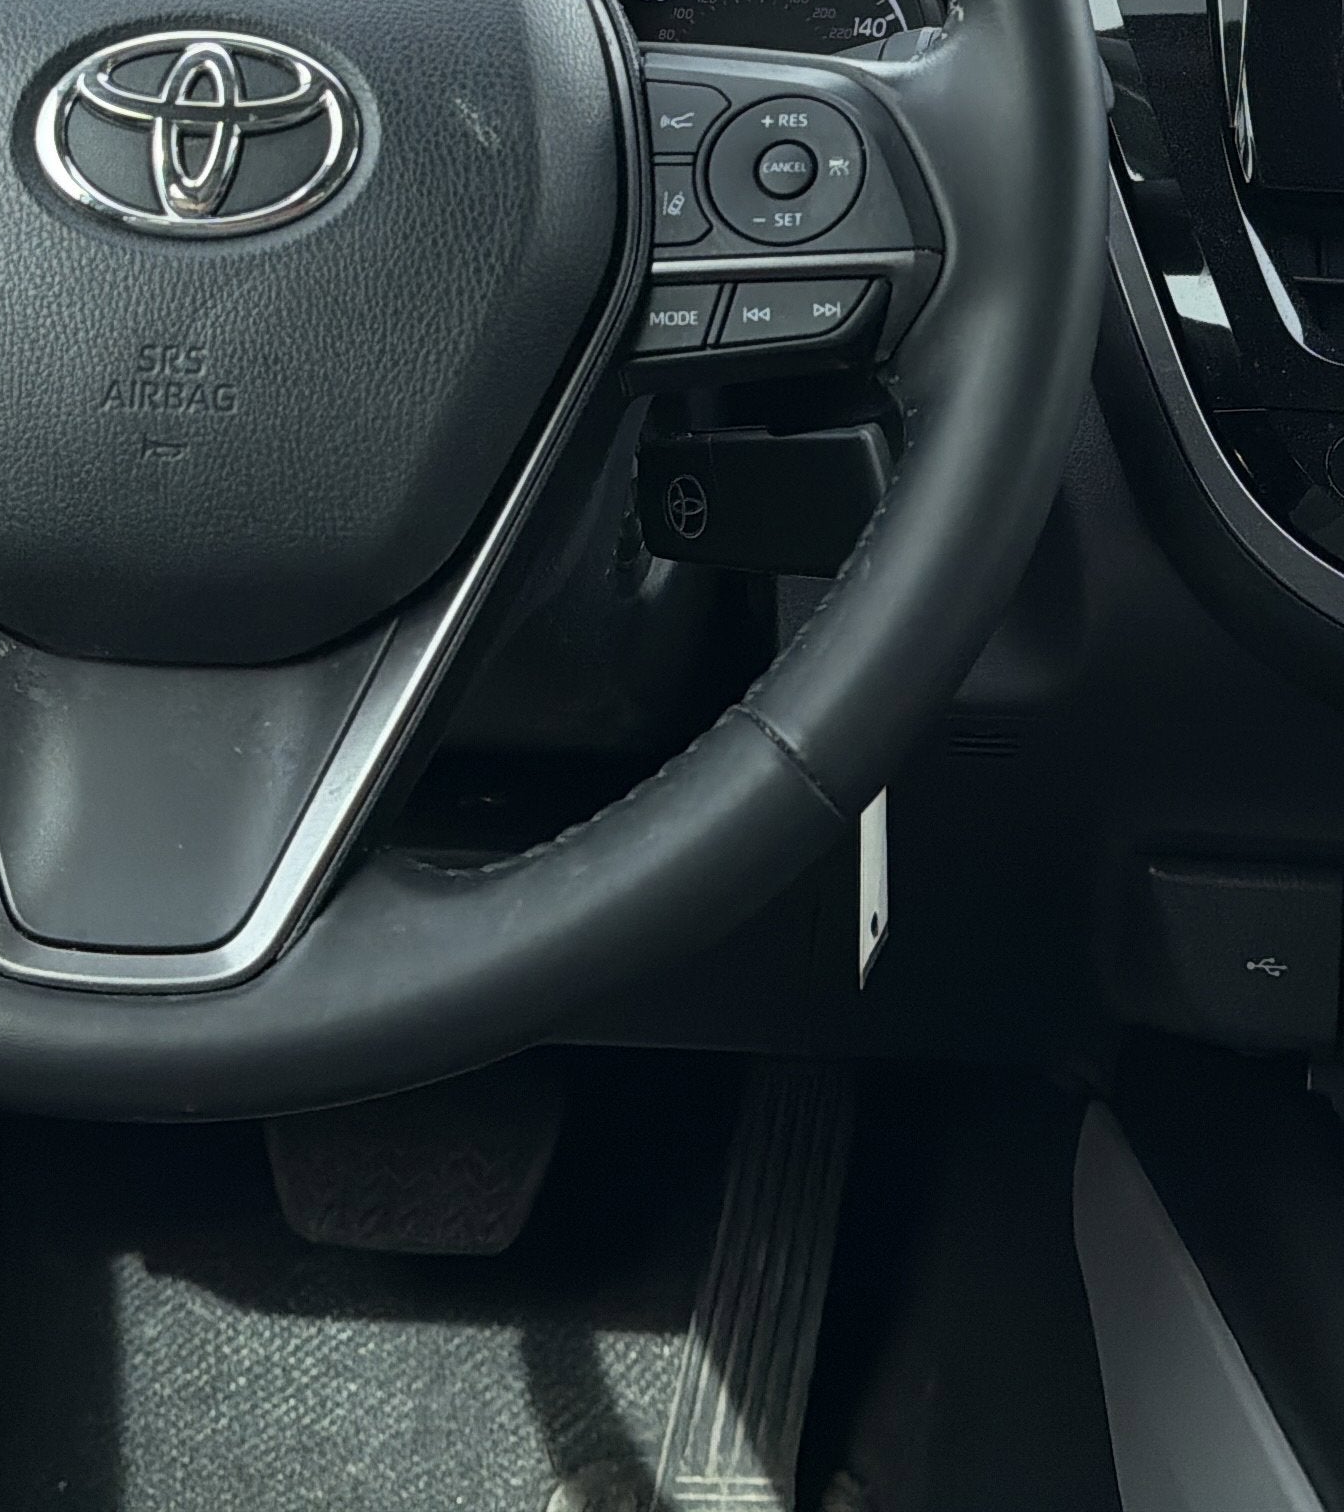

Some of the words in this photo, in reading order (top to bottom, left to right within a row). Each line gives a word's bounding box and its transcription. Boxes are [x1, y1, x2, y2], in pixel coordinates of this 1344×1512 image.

[673, 8, 694, 20] 100
[812, 7, 837, 19] 200
[658, 28, 676, 40] 80
[853, 17, 887, 38] 140
[778, 113, 808, 127] RES
[762, 161, 807, 174] CANCEL
[774, 212, 803, 227] SET
[649, 310, 699, 327] MODE
[136, 343, 207, 376] SRS
[102, 378, 239, 414] AIRBAG
